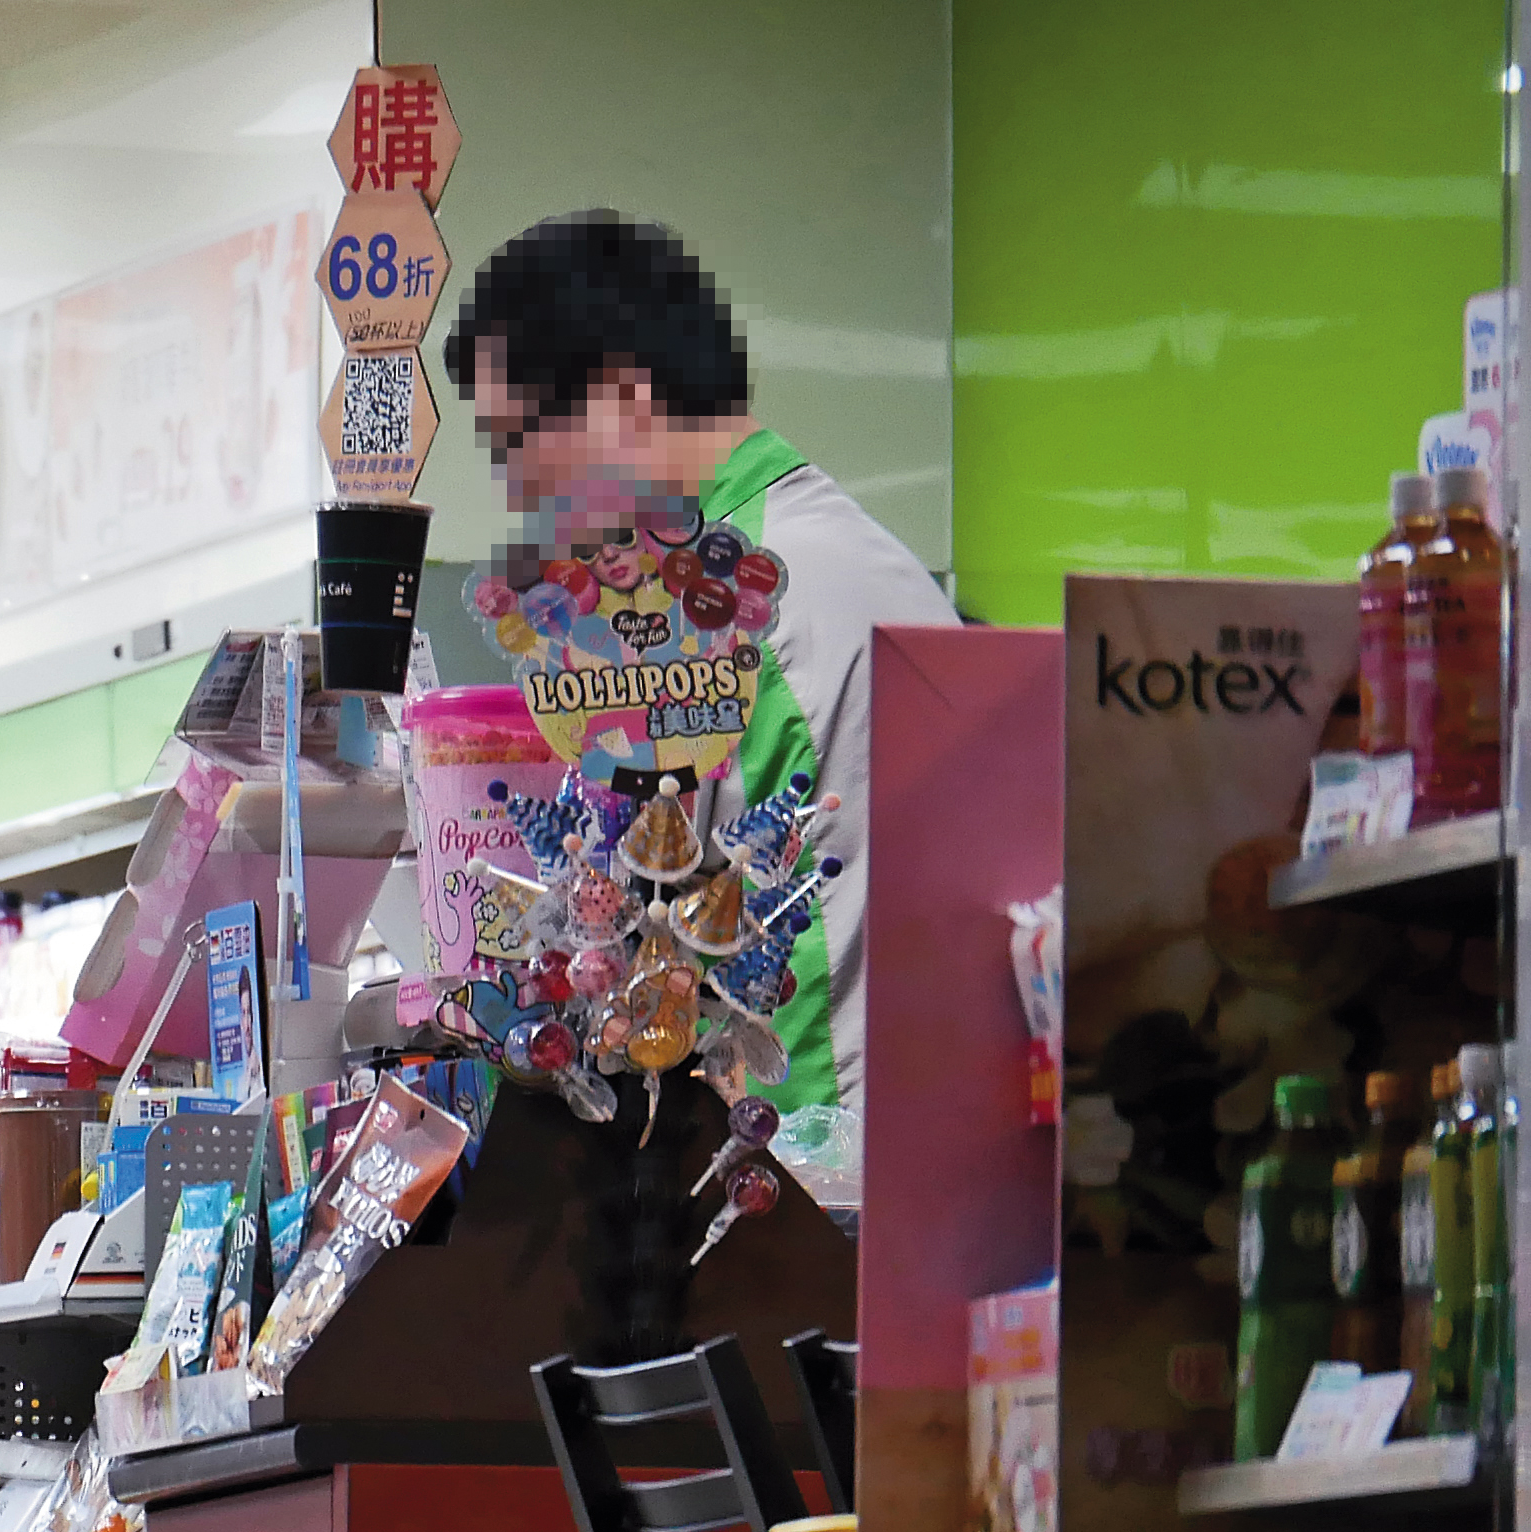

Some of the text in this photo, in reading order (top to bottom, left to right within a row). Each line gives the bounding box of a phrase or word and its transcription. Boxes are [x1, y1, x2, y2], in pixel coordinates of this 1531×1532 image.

[352, 80, 438, 193] 購
[329, 232, 435, 301] 68折
[531, 657, 738, 714] LOLLIPOPS
[1095, 632, 1305, 718] kotex
